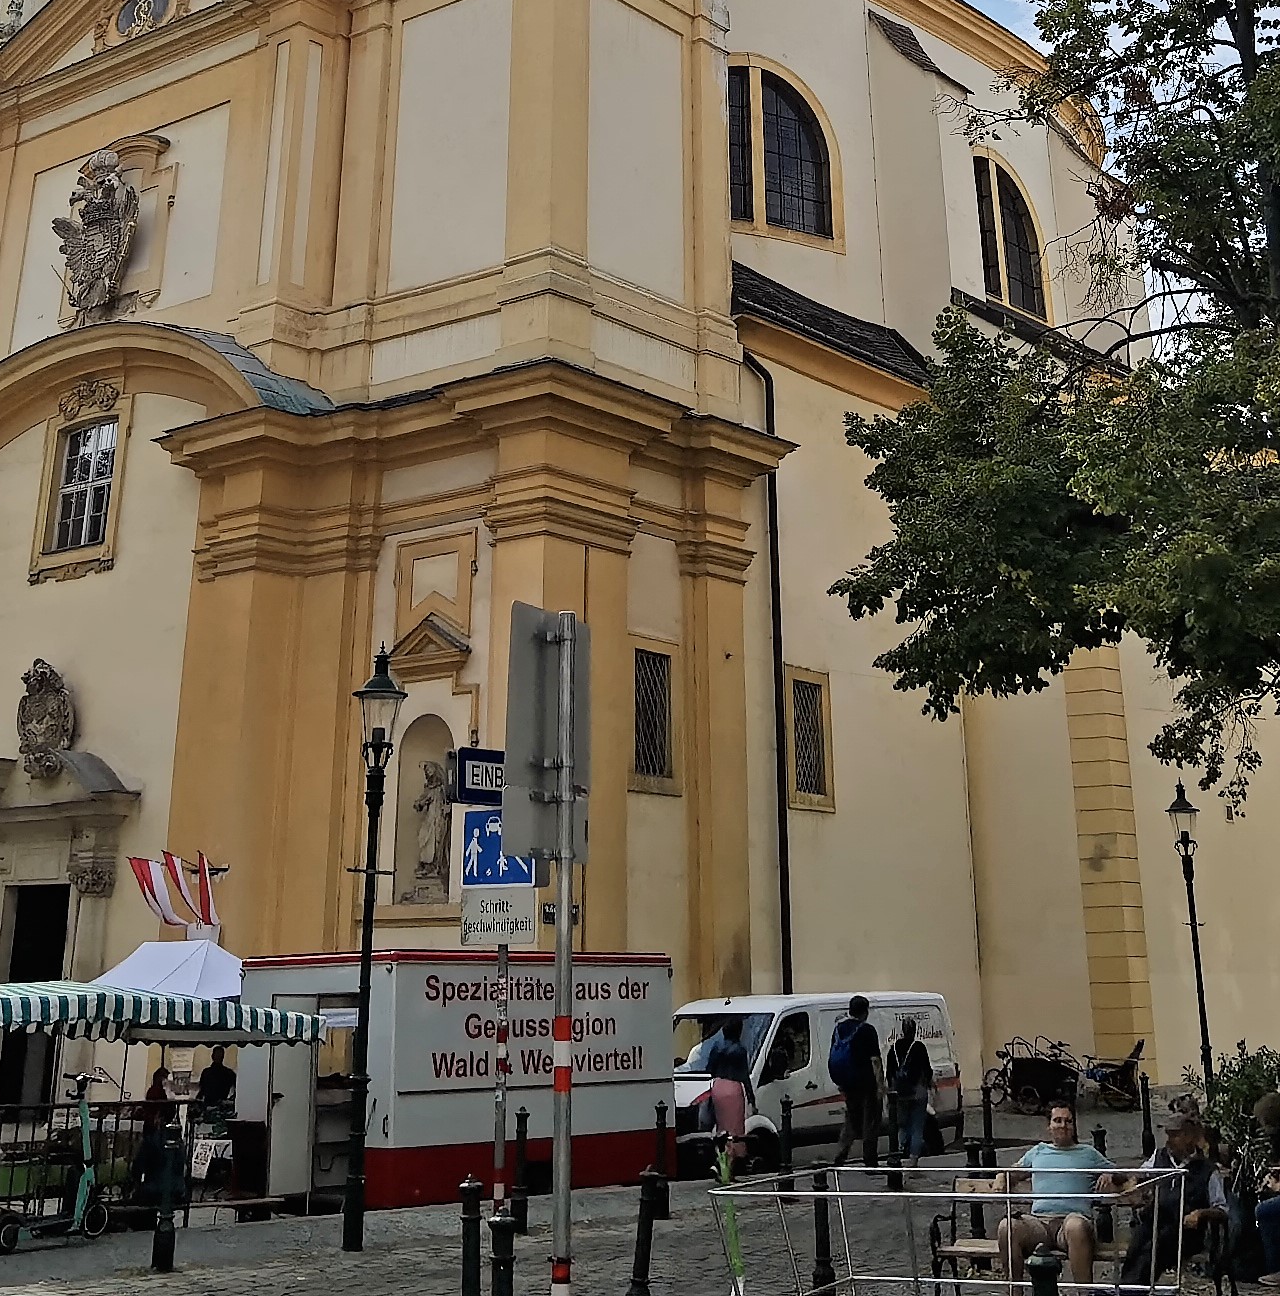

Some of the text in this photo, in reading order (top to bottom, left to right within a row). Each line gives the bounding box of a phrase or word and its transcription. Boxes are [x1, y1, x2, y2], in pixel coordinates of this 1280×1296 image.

[471, 764, 505, 788] EINB
[480, 898, 513, 914] Schritt-
[463, 916, 532, 935] geschwindigkeit
[424, 974, 650, 1008] Speziaitäte aus der
[464, 1011, 617, 1043] Geussgion
[431, 1050, 489, 1079] Wald
[520, 1045, 644, 1076] Weviertel!
